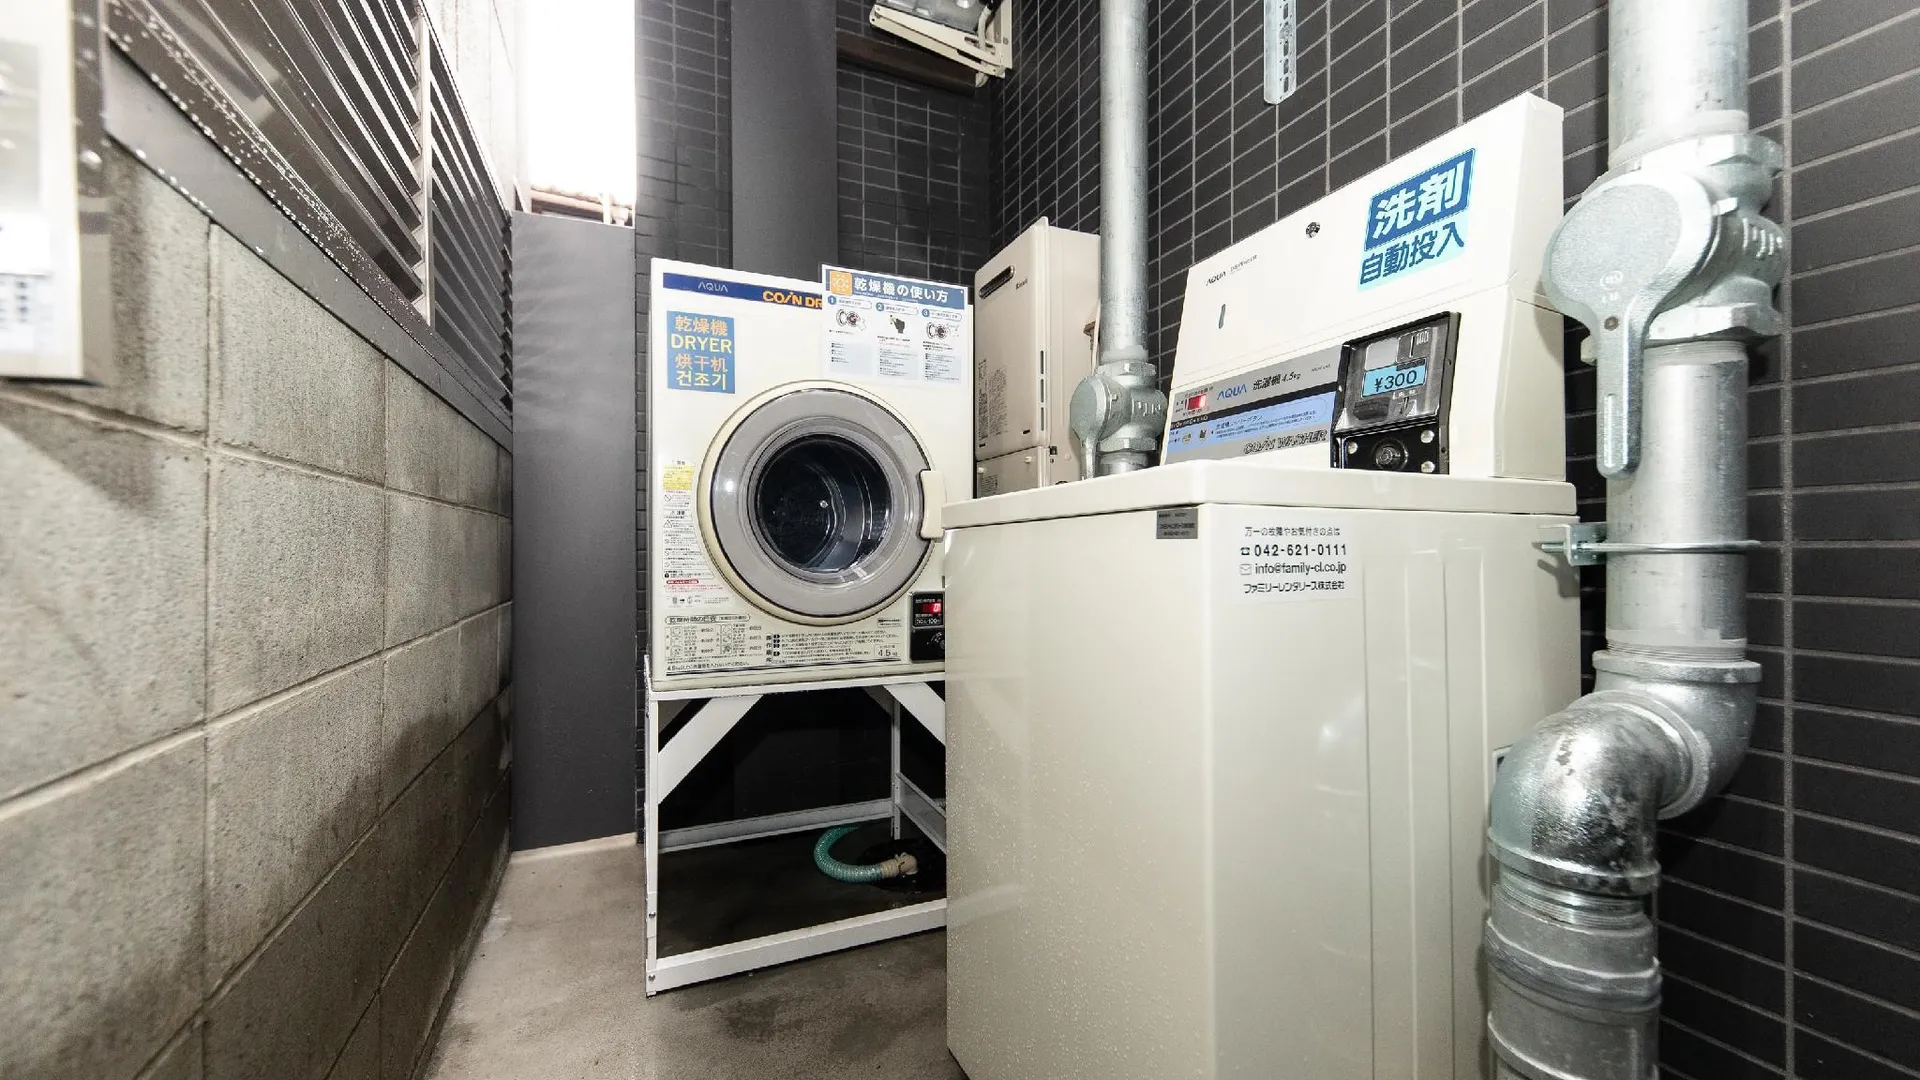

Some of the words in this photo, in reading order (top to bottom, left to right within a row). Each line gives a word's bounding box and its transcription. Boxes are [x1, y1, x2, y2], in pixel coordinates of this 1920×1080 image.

[1372, 161, 1466, 239] 洗剤
[1360, 221, 1465, 285] 自動投入
[698, 281, 728, 293] AQUA
[854, 276, 949, 303] 乾燥機の使い方
[675, 315, 728, 336] 乾燥機
[671, 333, 732, 354] DRYER
[674, 353, 728, 373] 烘干机
[676, 370, 726, 391] 건조기
[1374, 370, 1417, 393] ¥300
[1217, 384, 1247, 401] AQUA
[1277, 429, 1328, 449] WASHER
[1254, 543, 1347, 557] 042-621-0111
[1255, 561, 1347, 575] info@family-cl.co.jp
